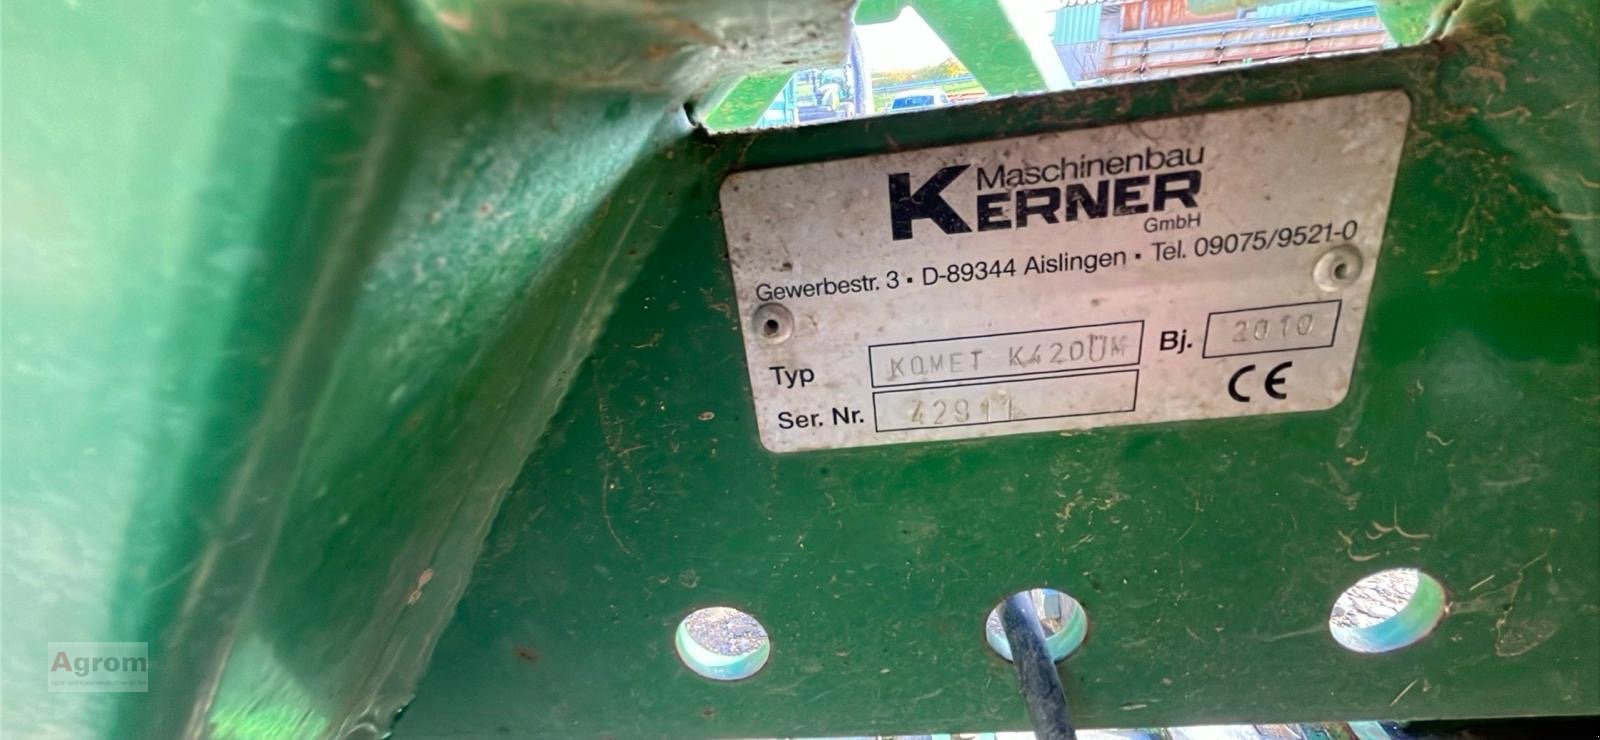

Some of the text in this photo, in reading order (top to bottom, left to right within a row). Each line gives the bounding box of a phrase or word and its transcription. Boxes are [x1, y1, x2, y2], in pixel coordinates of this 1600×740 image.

[976, 146, 1205, 191] Maschinenbau
[888, 163, 1203, 241] KERNER
[1144, 212, 1201, 233] GmbH
[756, 220, 1358, 302] Gewerbestr. 3 D-89344 Aislingen Tel. 09075/9521-0
[1159, 313, 1314, 354] Bj. 2010
[769, 366, 815, 390] Typ
[888, 349, 984, 382] KOMET
[777, 412, 824, 430] Ser.
[832, 407, 865, 425] Nr.
